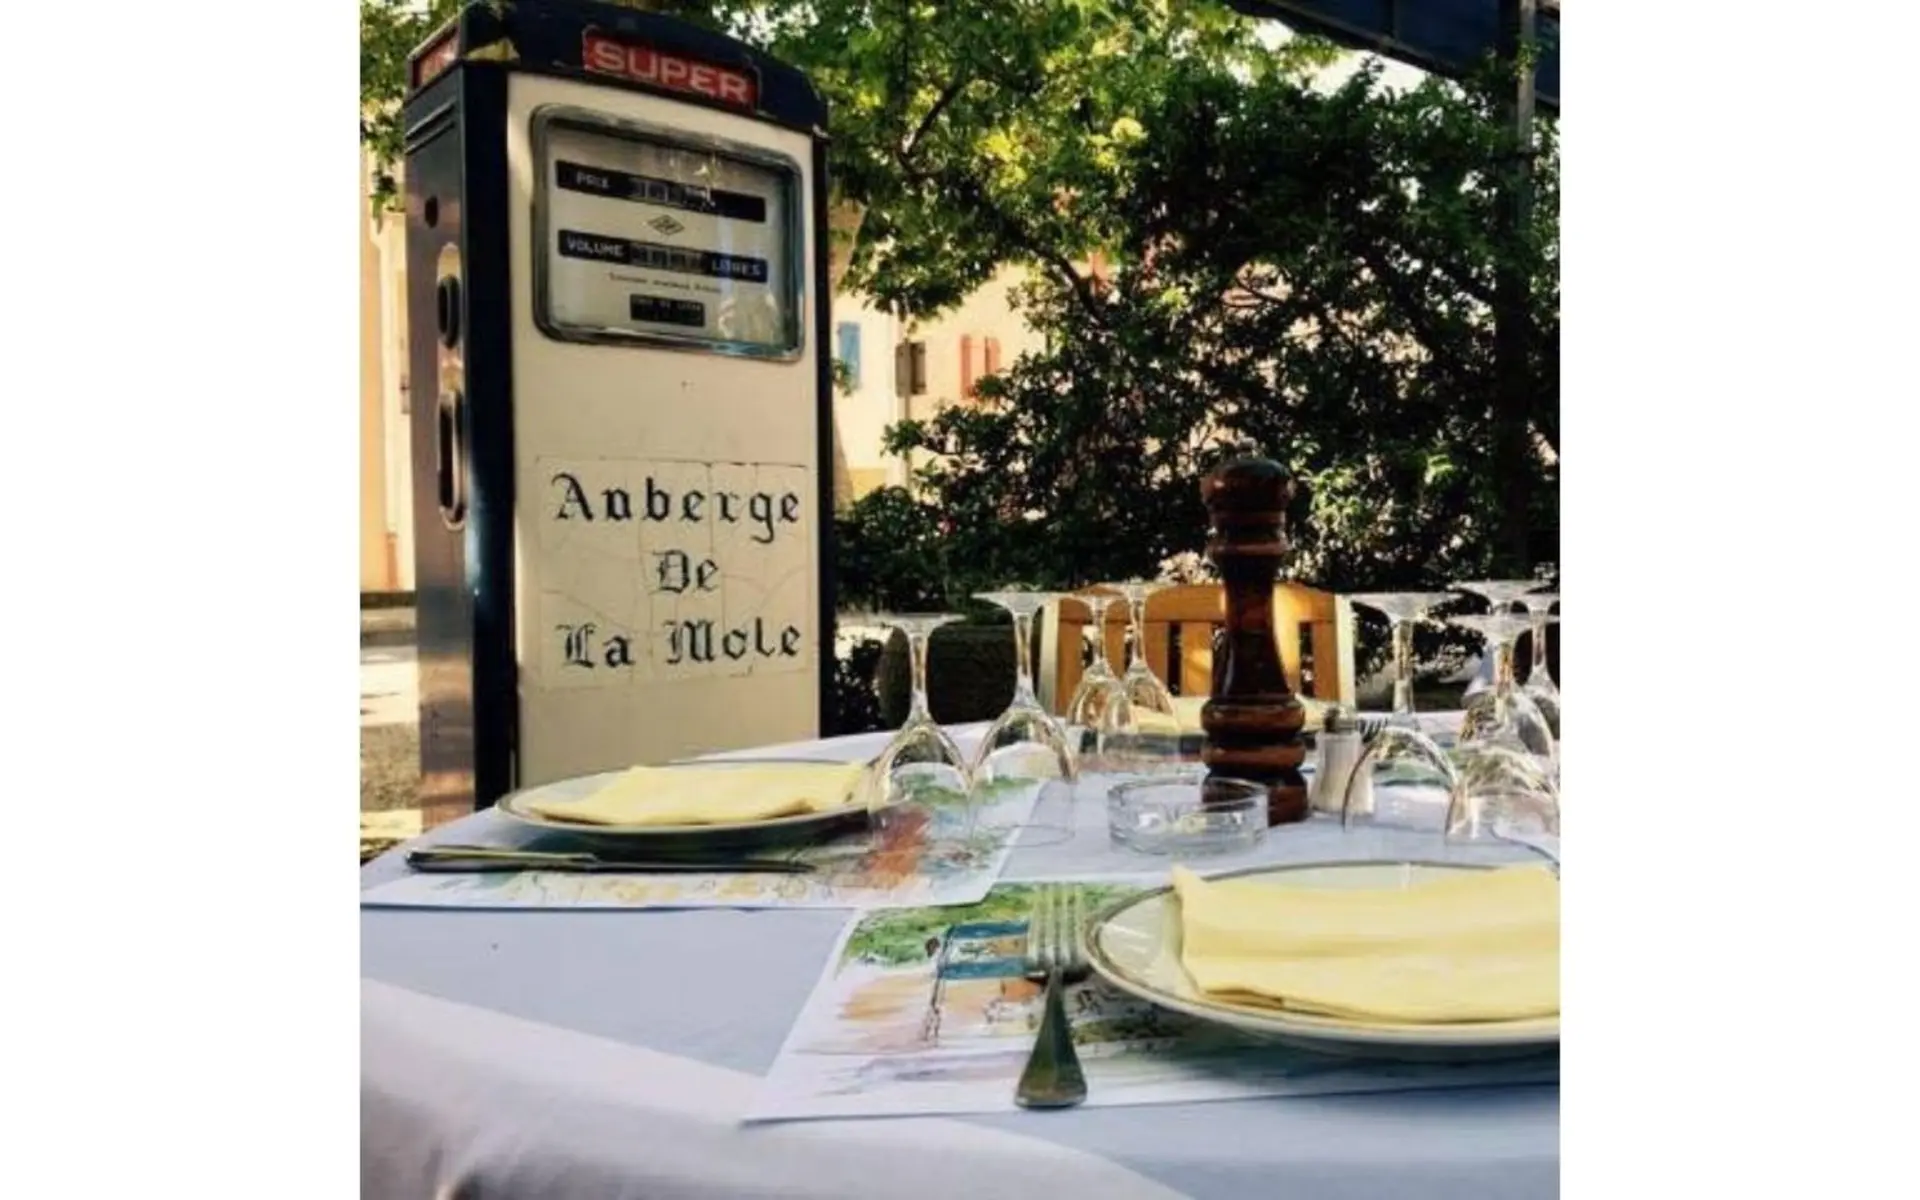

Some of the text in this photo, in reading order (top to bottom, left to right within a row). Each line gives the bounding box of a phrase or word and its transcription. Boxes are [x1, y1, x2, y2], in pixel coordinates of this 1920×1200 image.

[593, 39, 749, 99] SUPER
[566, 236, 624, 257] VOLUME
[652, 550, 719, 593] De
[555, 617, 801, 668] La Mole
